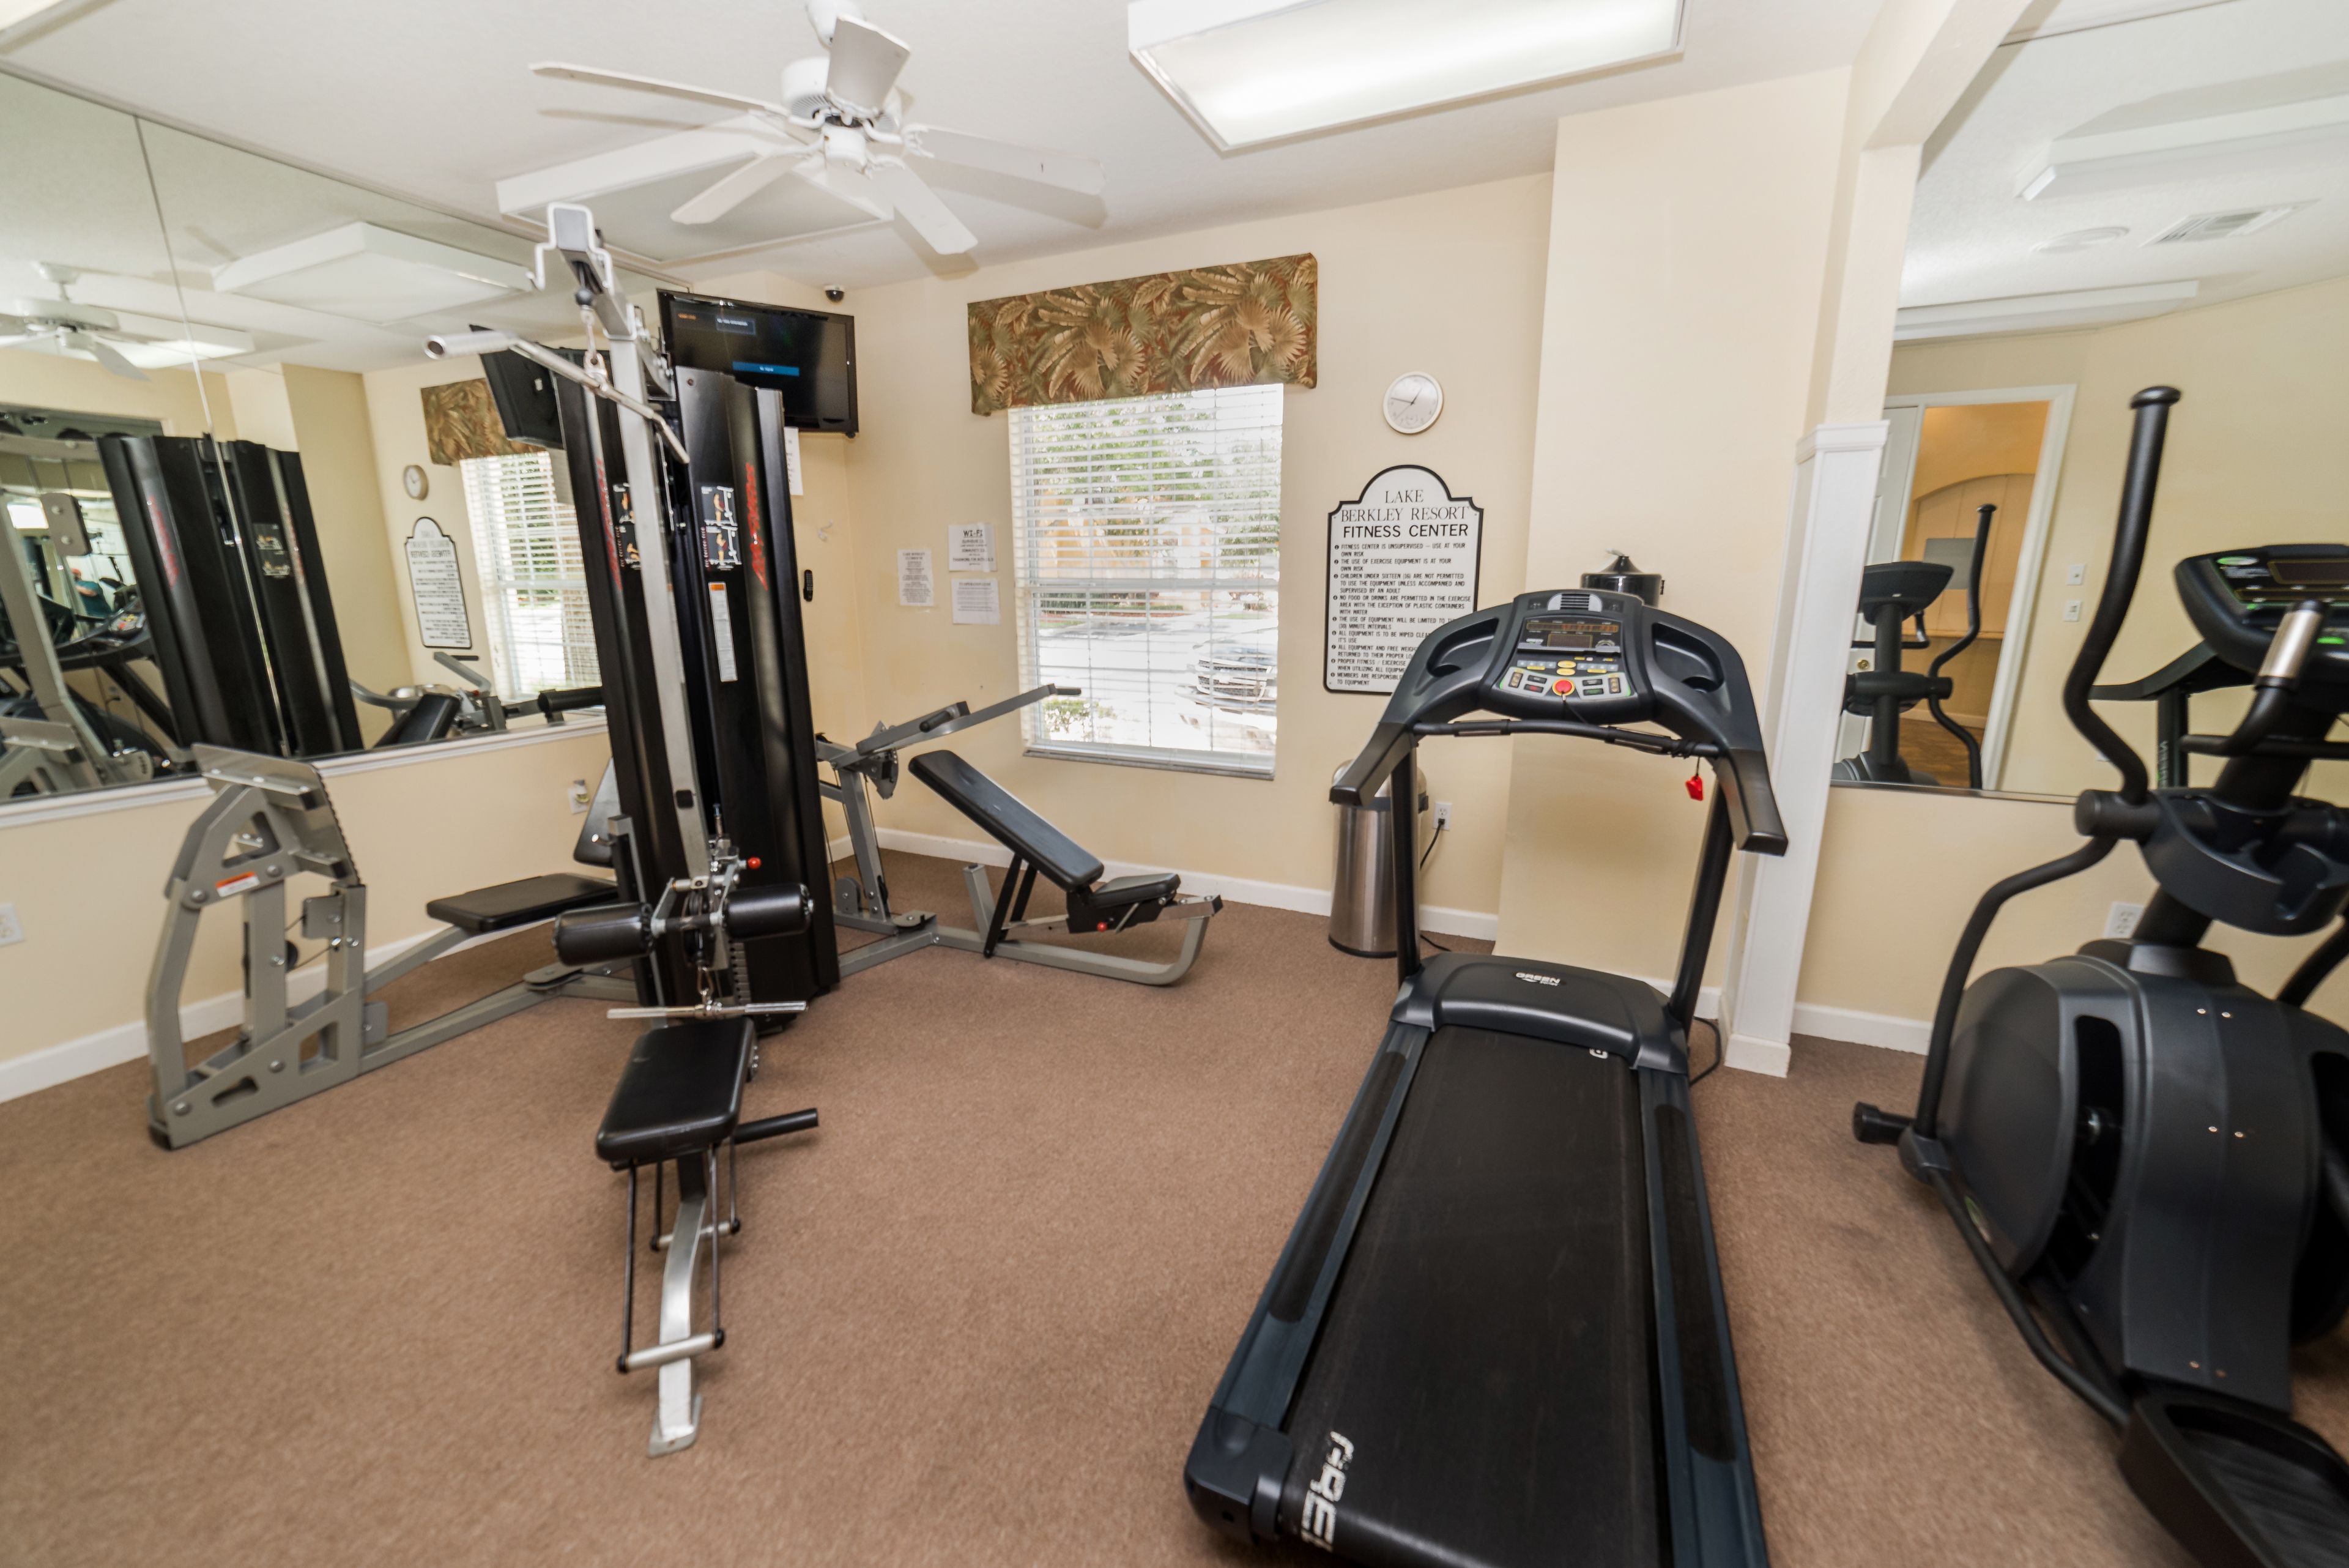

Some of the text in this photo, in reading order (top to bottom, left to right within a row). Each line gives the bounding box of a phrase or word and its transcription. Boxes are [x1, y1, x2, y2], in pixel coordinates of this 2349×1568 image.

[1385, 489, 1423, 503] LAKE
[1341, 505, 1469, 522] BERKLEY RESORT
[1343, 524, 1468, 538] FITNESS CENTER
